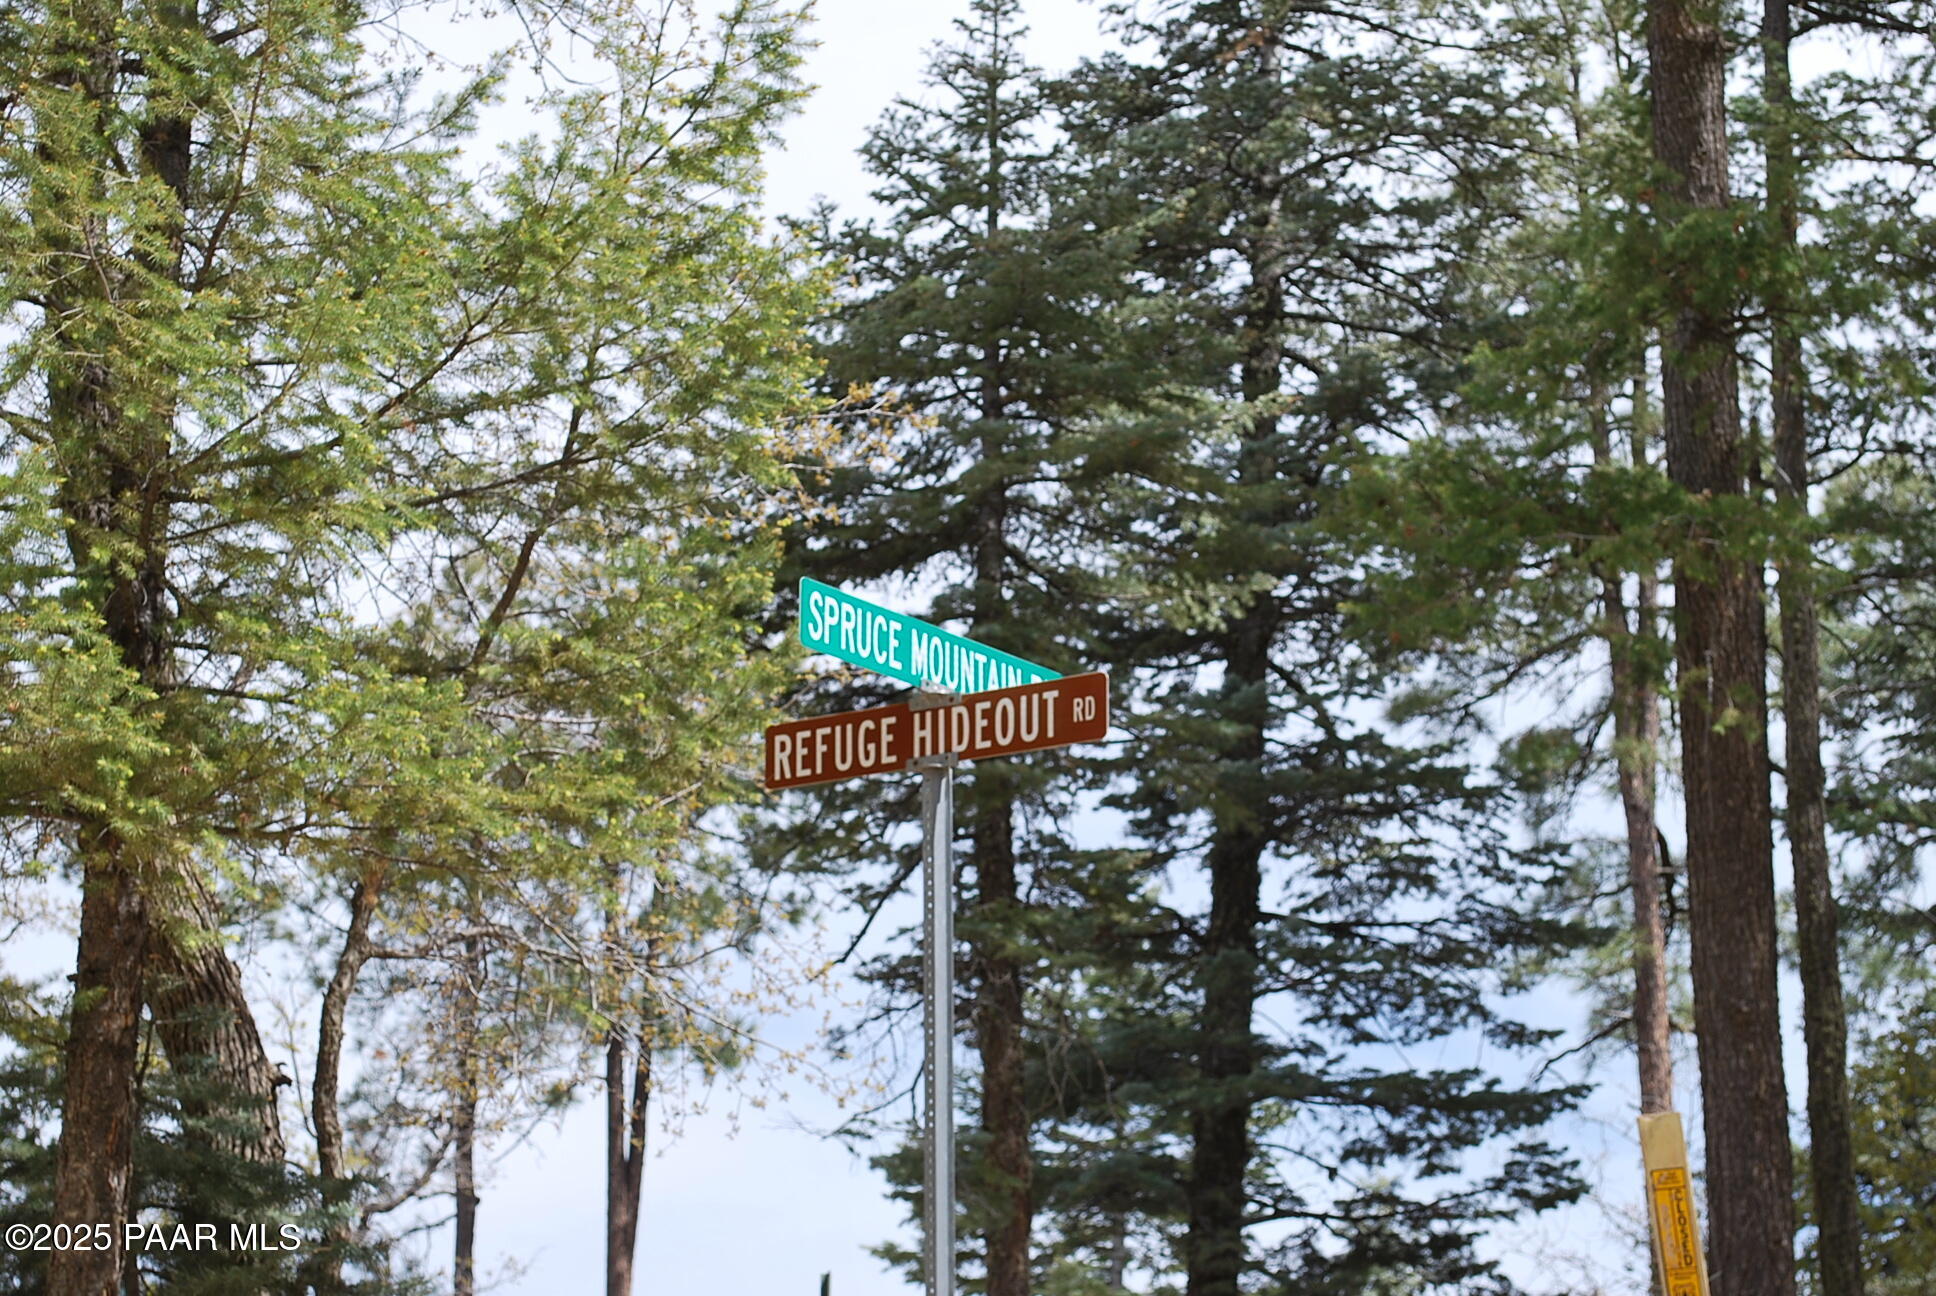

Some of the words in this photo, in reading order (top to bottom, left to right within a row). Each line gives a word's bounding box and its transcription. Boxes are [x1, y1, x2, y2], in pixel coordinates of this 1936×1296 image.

[807, 590, 903, 671] SPRUCE
[774, 716, 898, 781] REFUGE
[913, 689, 1060, 759] HIDEOUT
[1072, 695, 1096, 723] RD
